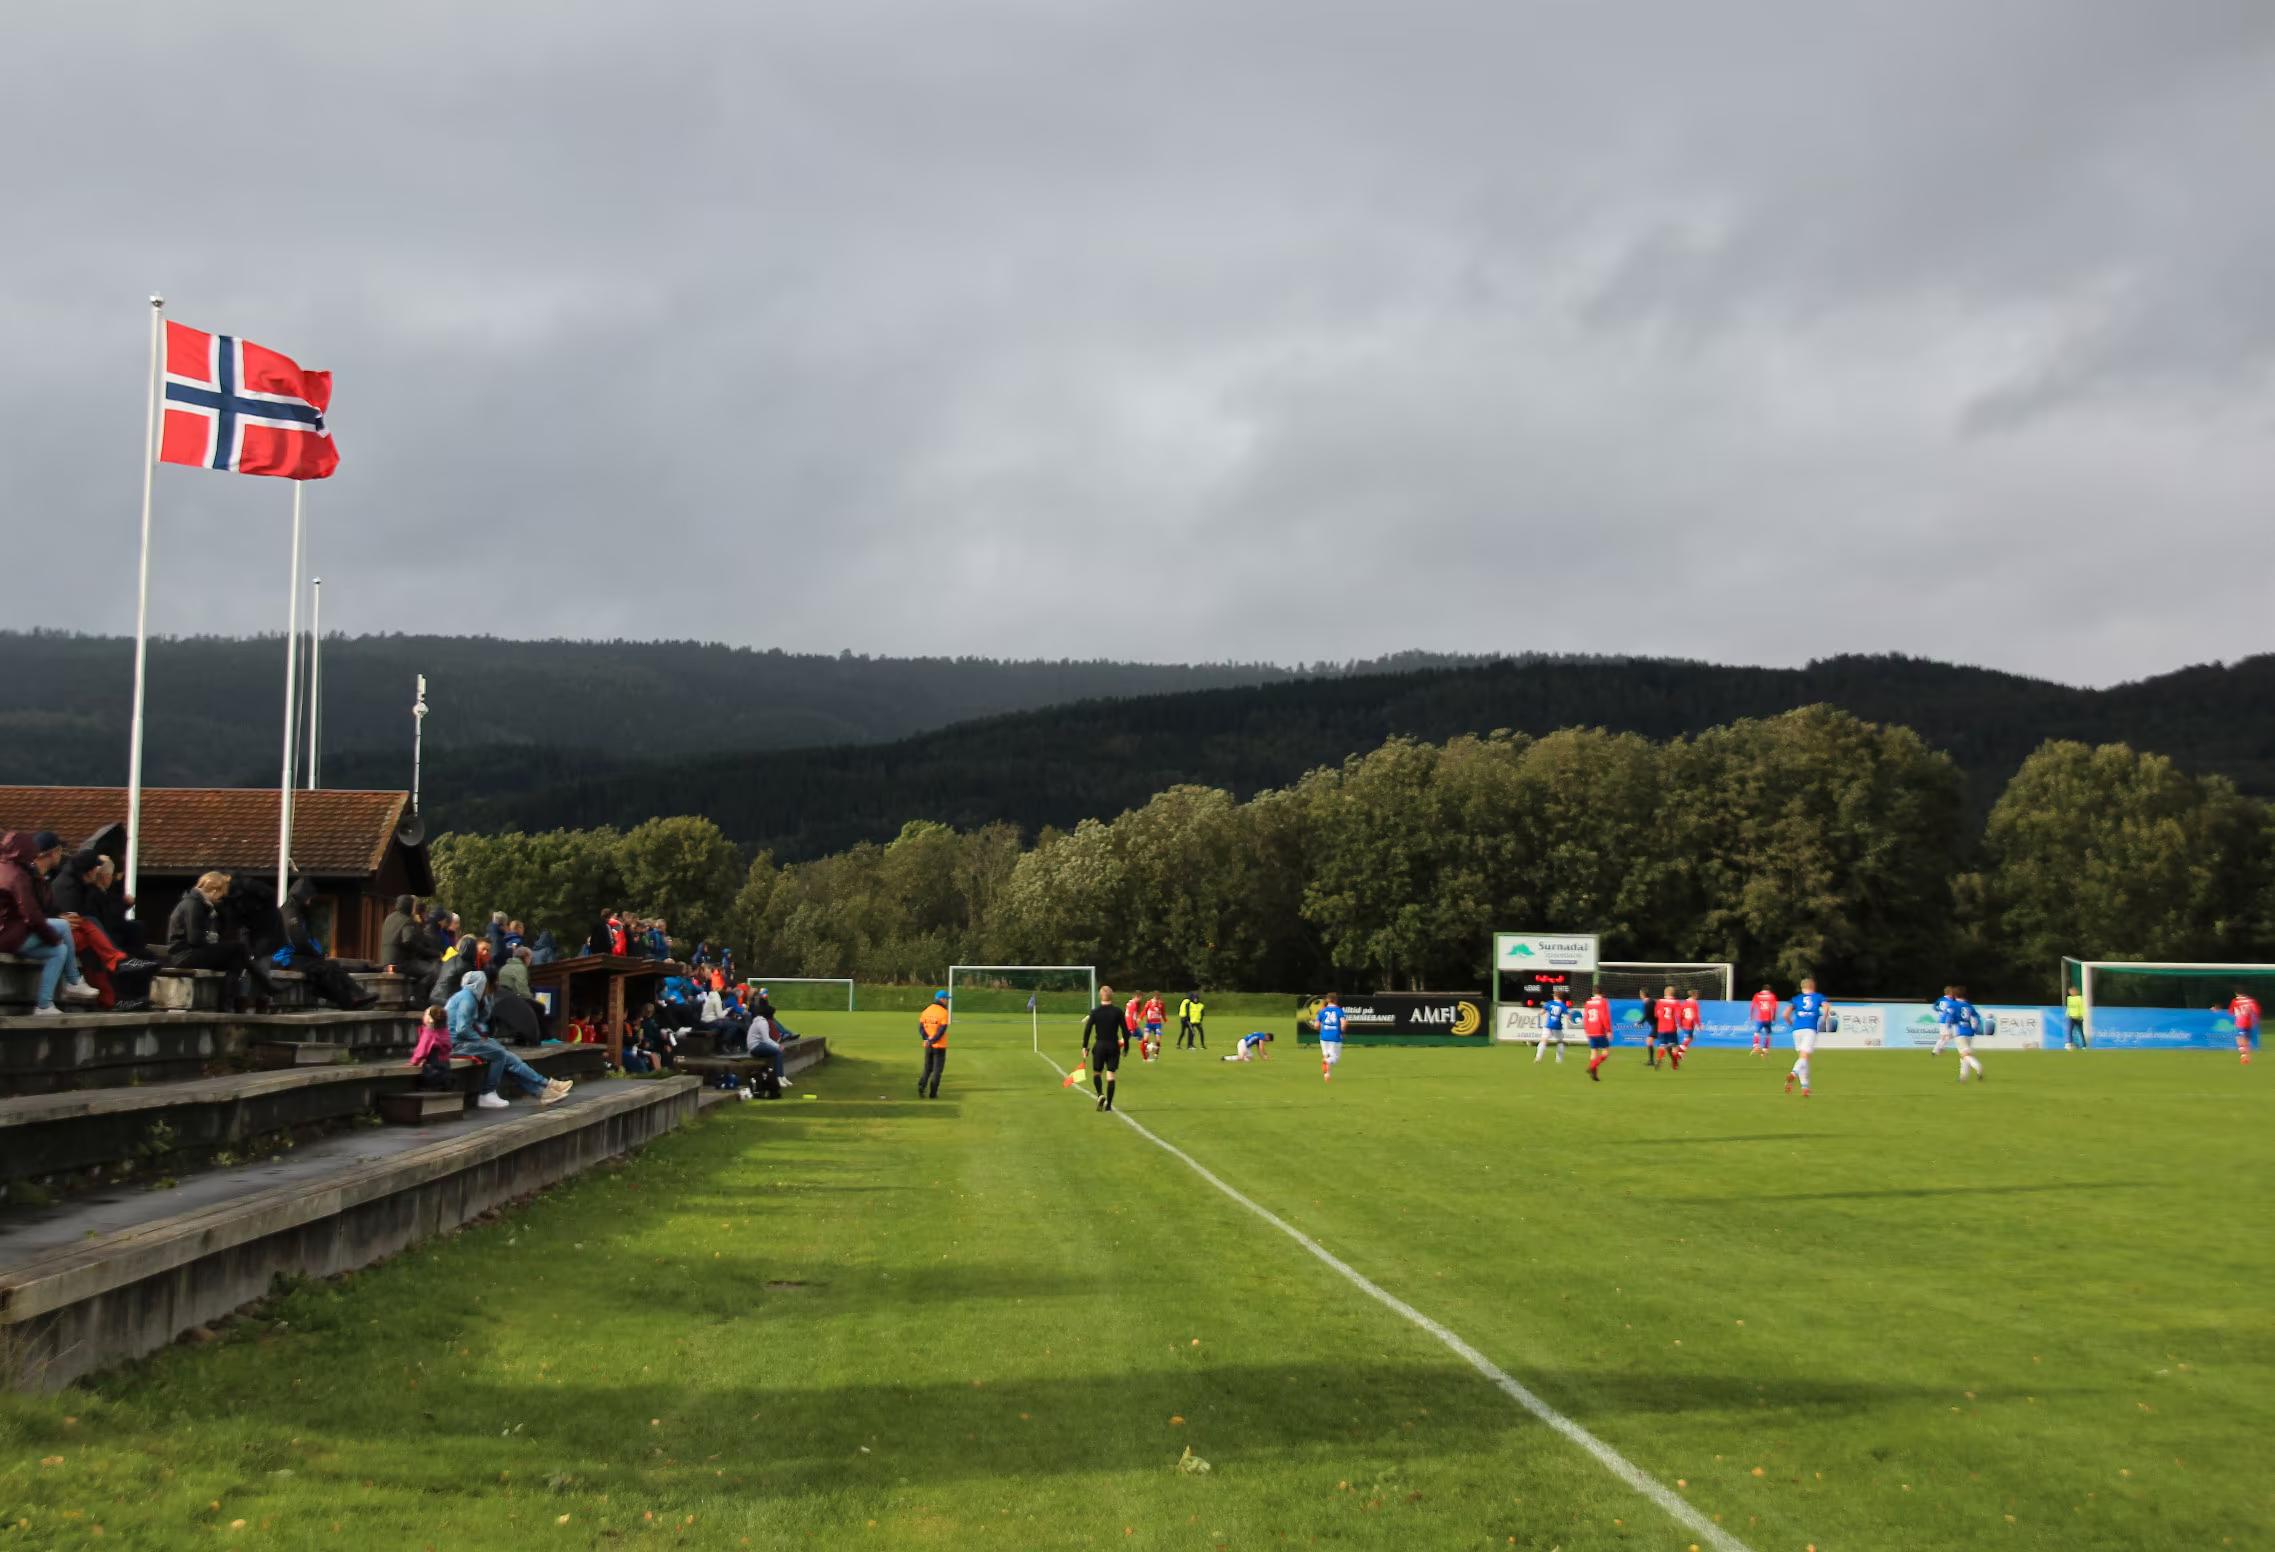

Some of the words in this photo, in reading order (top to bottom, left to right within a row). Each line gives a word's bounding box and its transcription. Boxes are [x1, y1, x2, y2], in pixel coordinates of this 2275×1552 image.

[1538, 941, 1588, 951] Surnadal
[1803, 996, 1812, 1010] 5
[1342, 1006, 1362, 1014] lltid
[1409, 1005, 1456, 1024] AMFI
[1324, 1011, 1337, 1024] 24
[1842, 1015, 1880, 1025] FAIR
[1999, 1017, 2036, 1027] FAIR
